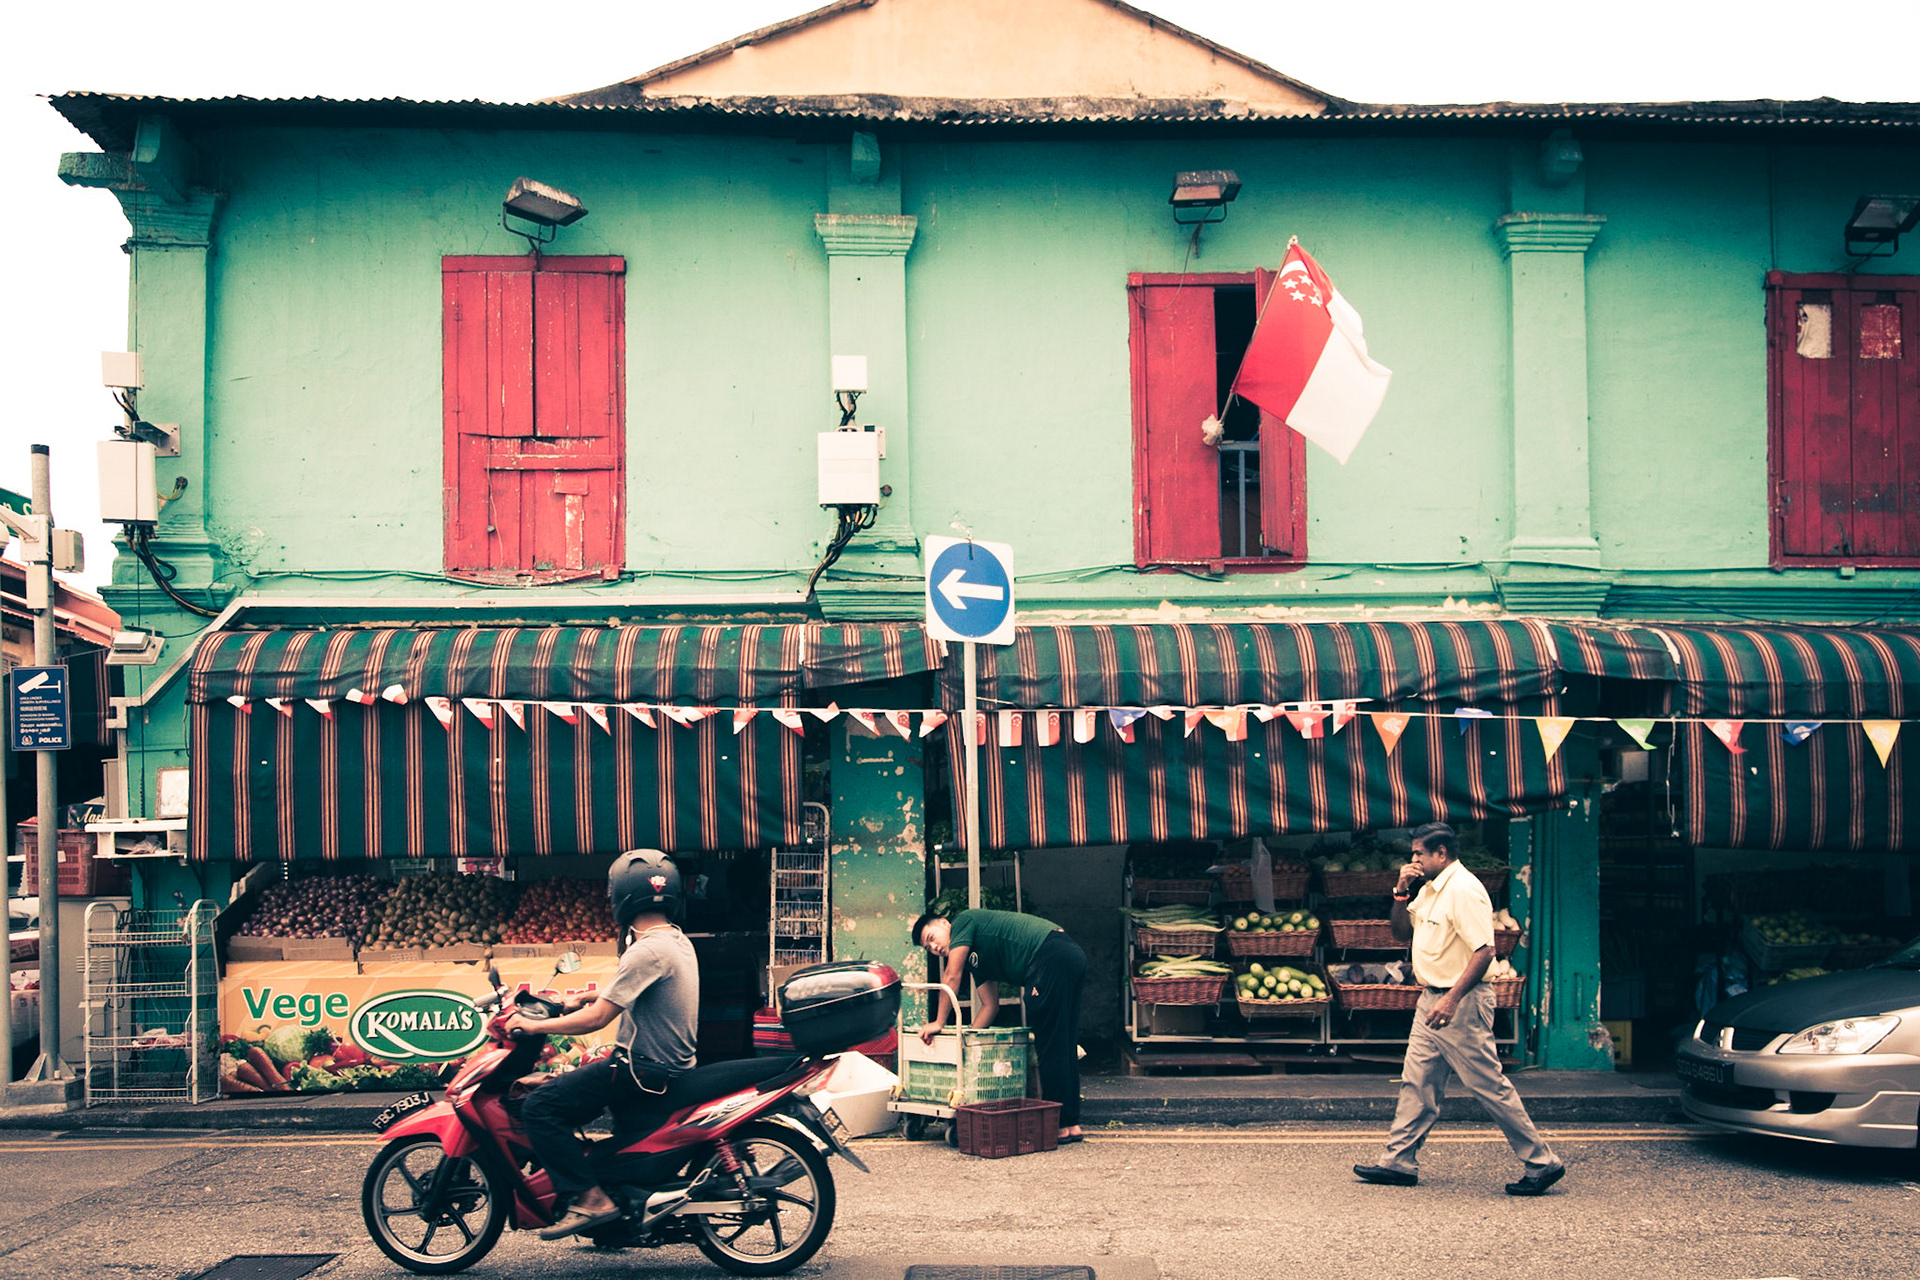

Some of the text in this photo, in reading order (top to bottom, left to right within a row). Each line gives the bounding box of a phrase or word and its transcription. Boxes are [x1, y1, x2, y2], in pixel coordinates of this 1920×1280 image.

[242, 987, 349, 1026] Vege
[365, 1005, 474, 1038] KOMALA'S
[371, 1108, 395, 1129] FBC
